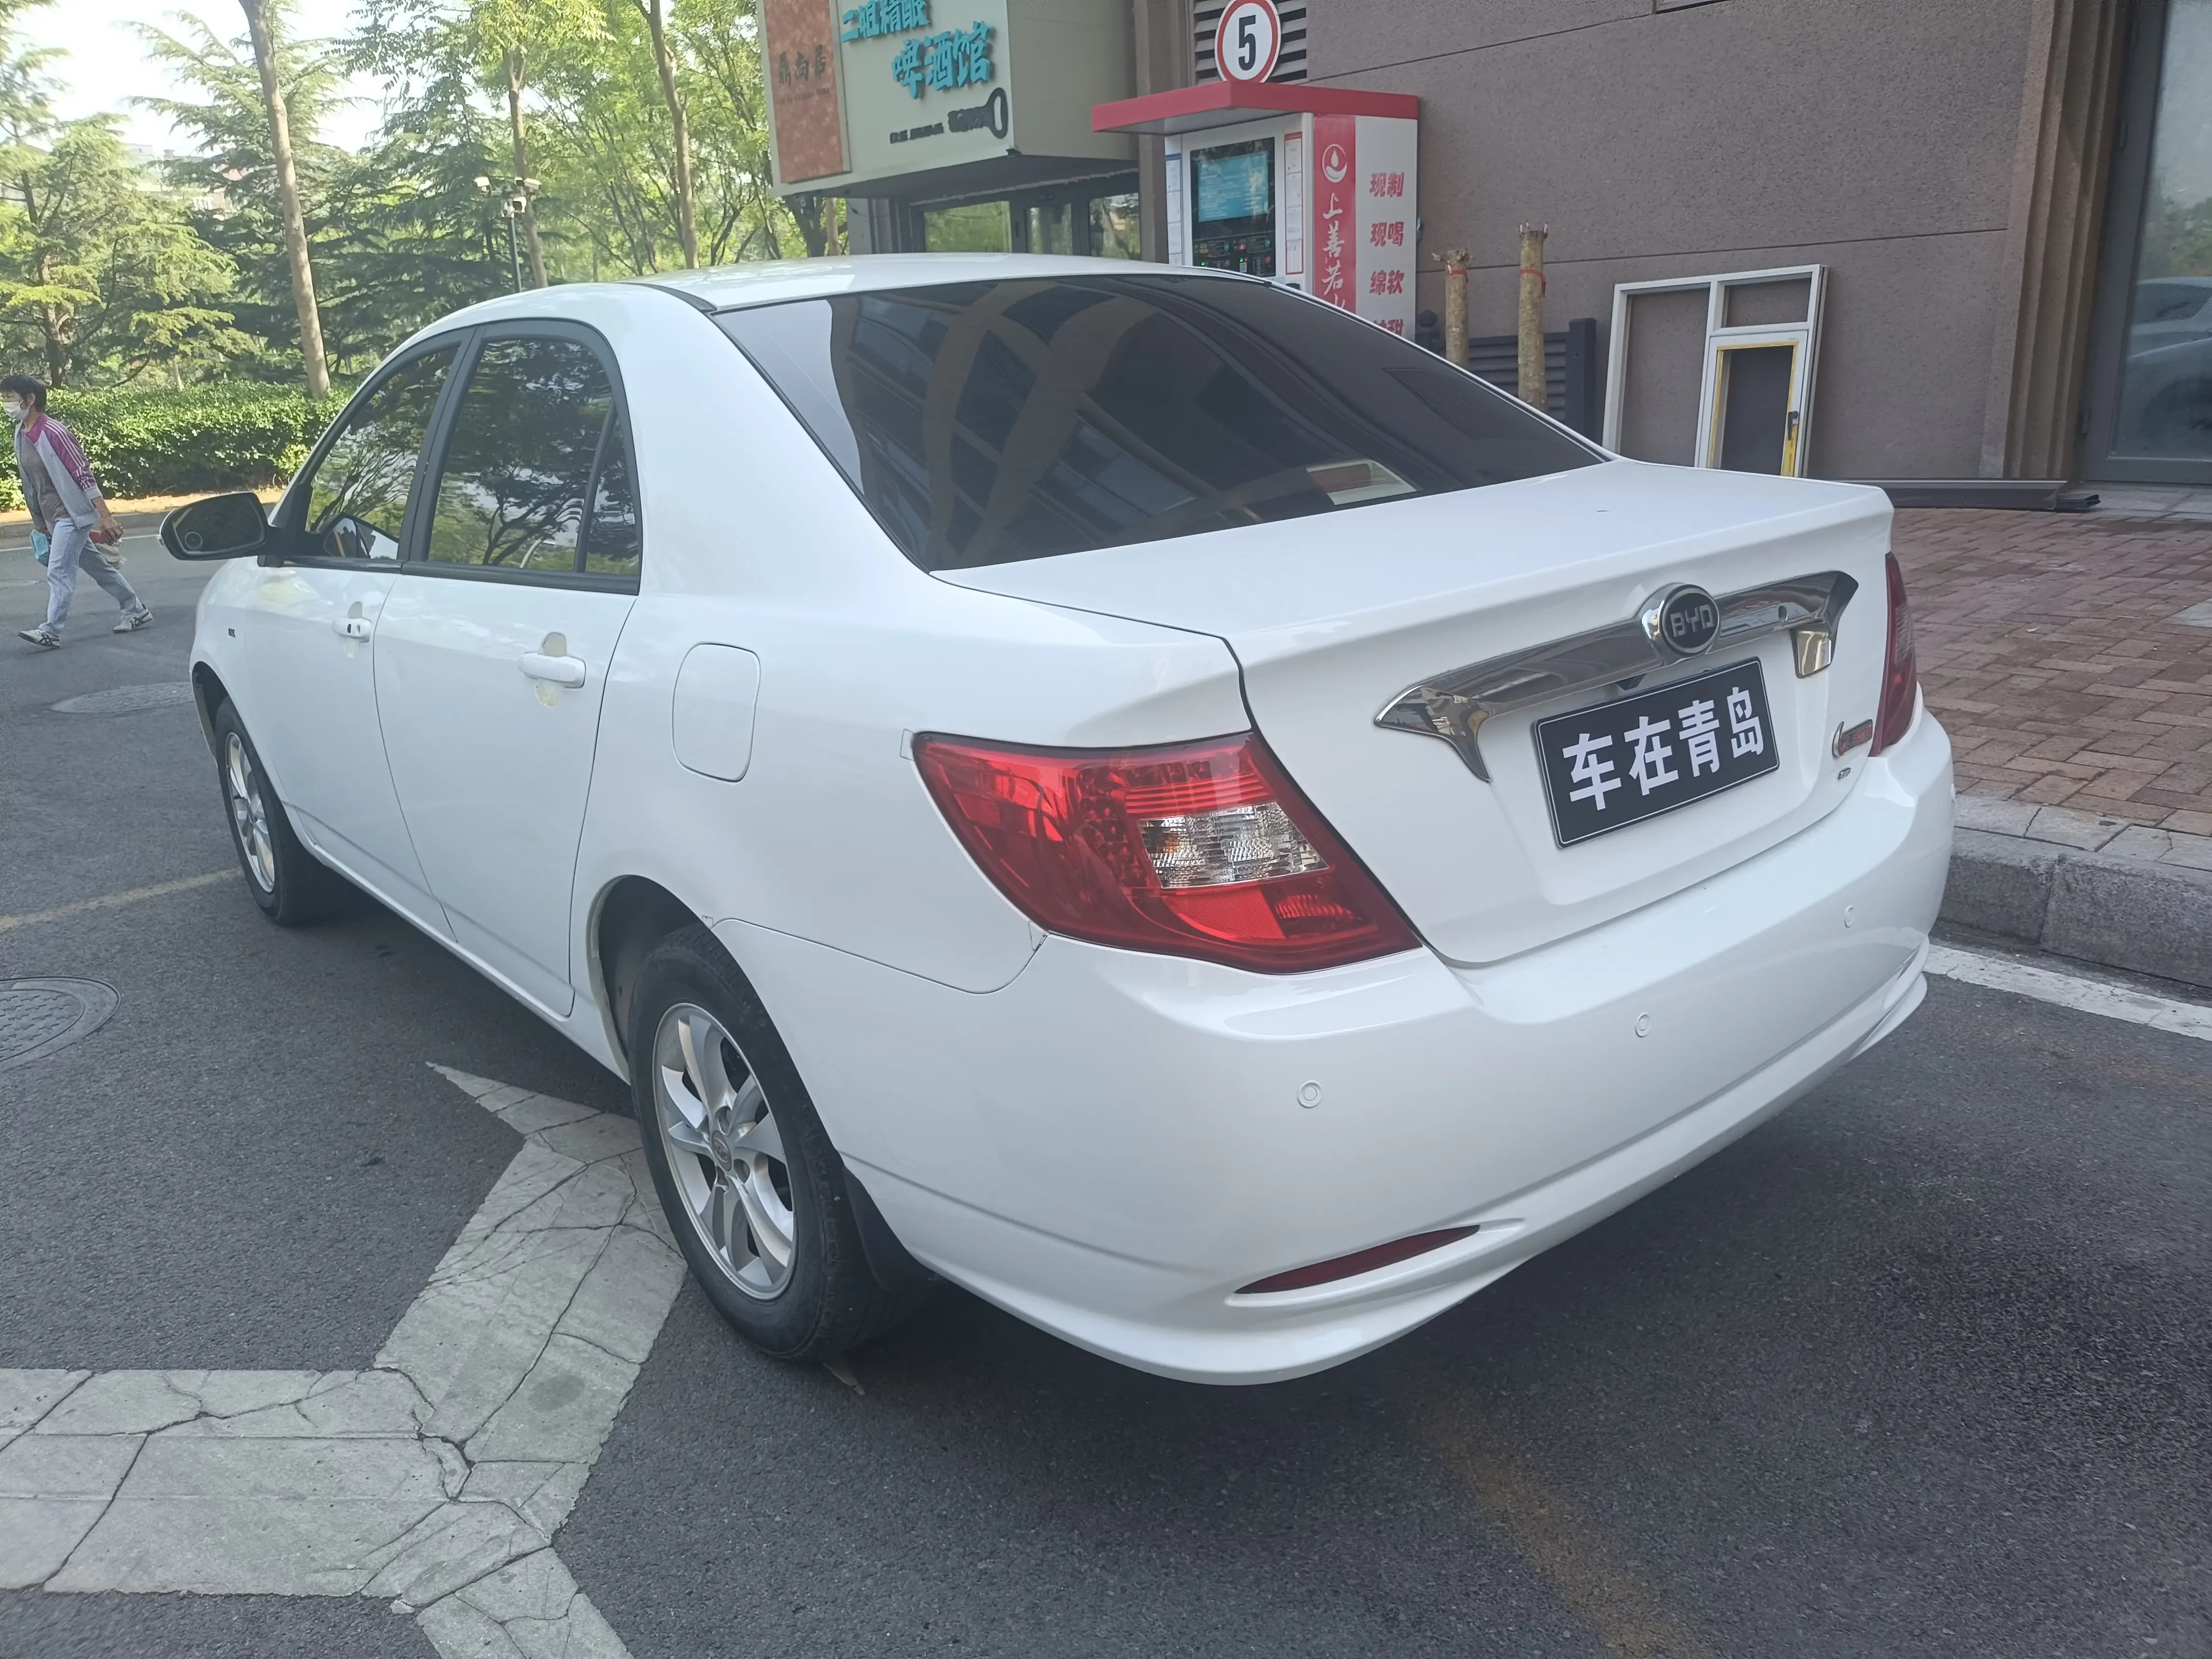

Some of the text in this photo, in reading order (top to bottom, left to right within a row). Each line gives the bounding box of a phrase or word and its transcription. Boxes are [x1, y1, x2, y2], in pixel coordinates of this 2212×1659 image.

[1238, 15, 1257, 71] 5
[892, 21, 991, 100] 啤酒馆
[1369, 172, 1404, 198] 现制
[1370, 221, 1404, 247] 现喝
[1370, 270, 1405, 295] 绵软
[1670, 604, 1715, 638] BYD
[1562, 686, 1764, 811] 车在青岛
